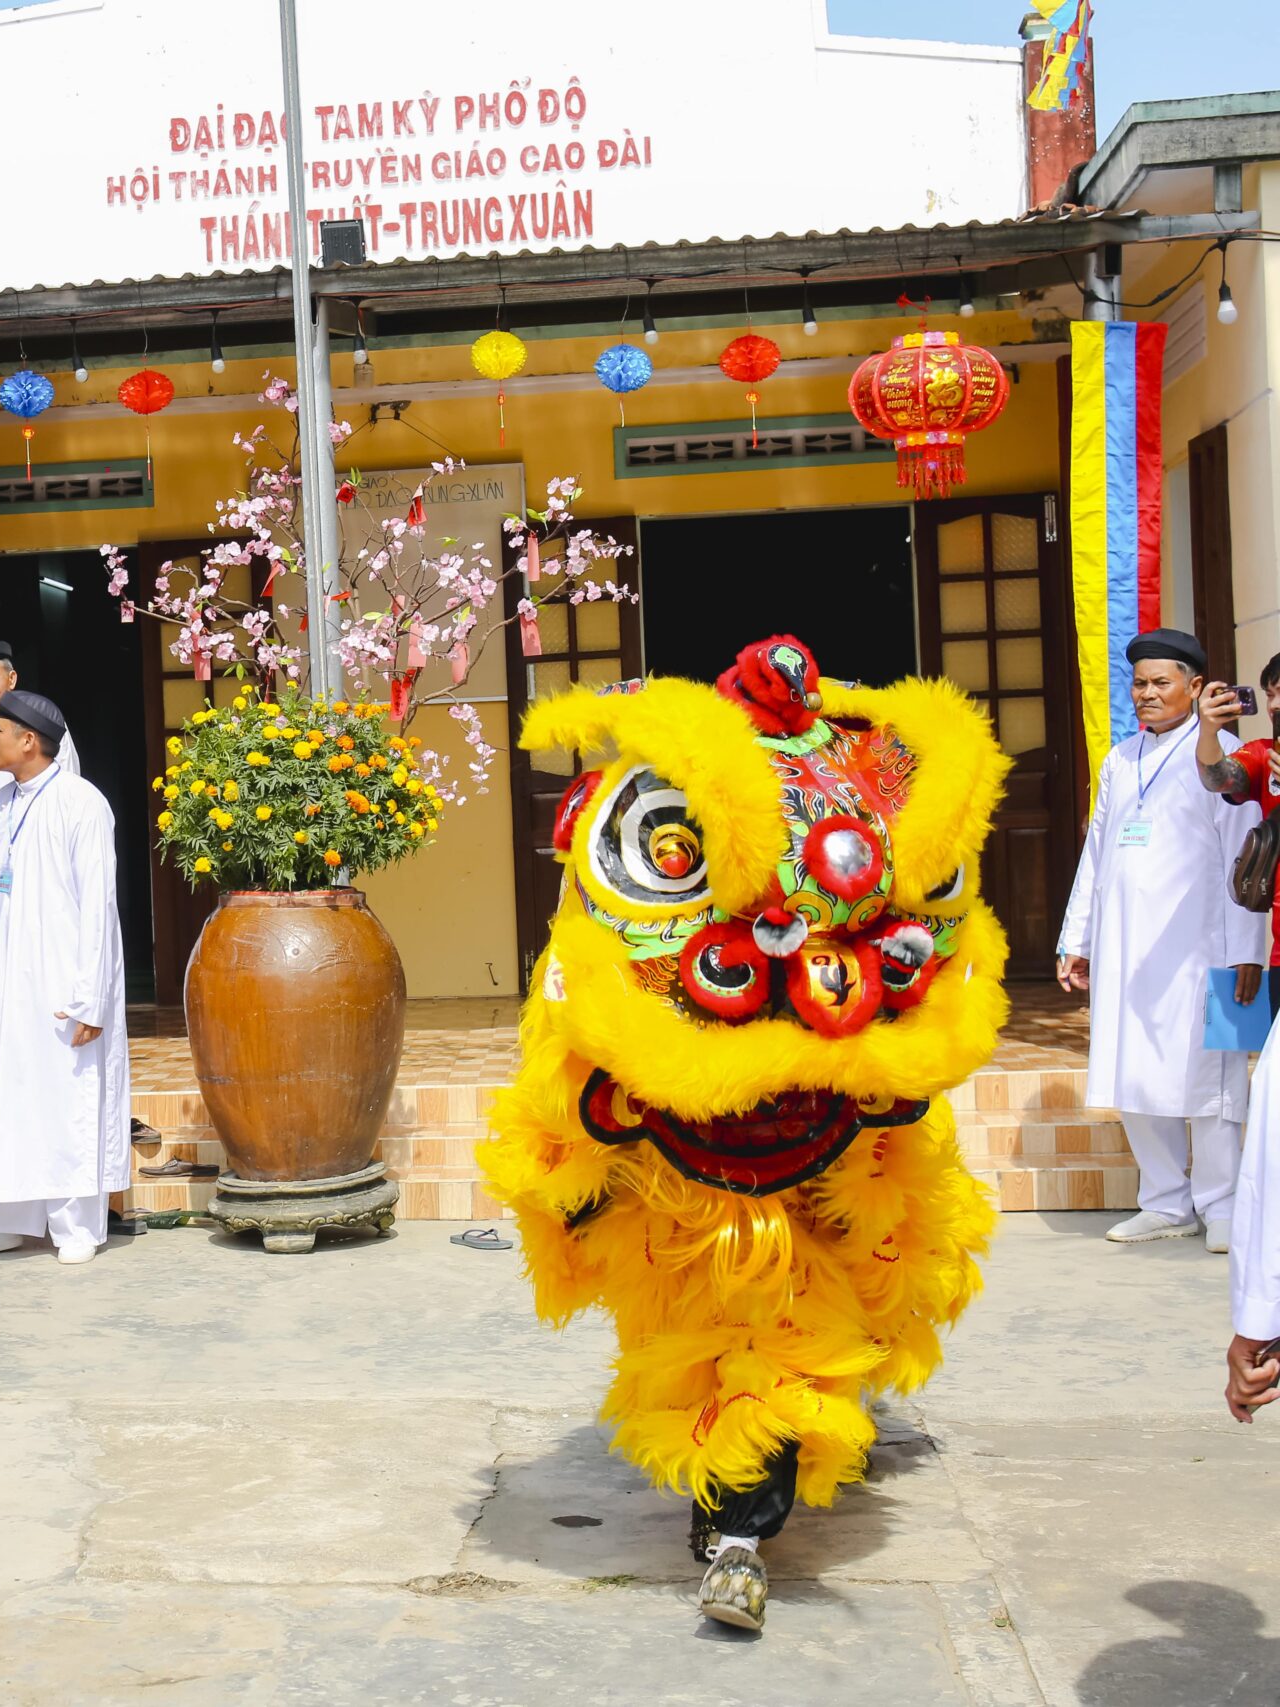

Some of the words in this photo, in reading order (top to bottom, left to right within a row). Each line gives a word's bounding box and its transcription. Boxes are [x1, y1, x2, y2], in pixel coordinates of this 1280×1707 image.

[315, 104, 383, 141] TAM
[454, 76, 531, 131] PHỔ
[538, 75, 587, 130] ĐỘ
[169, 159, 277, 199] THÁNH
[304, 146, 422, 189] RUYỀN
[431, 140, 507, 179] GIÁO
[520, 141, 586, 173] CAO
[597, 128, 652, 168] ĐÀI
